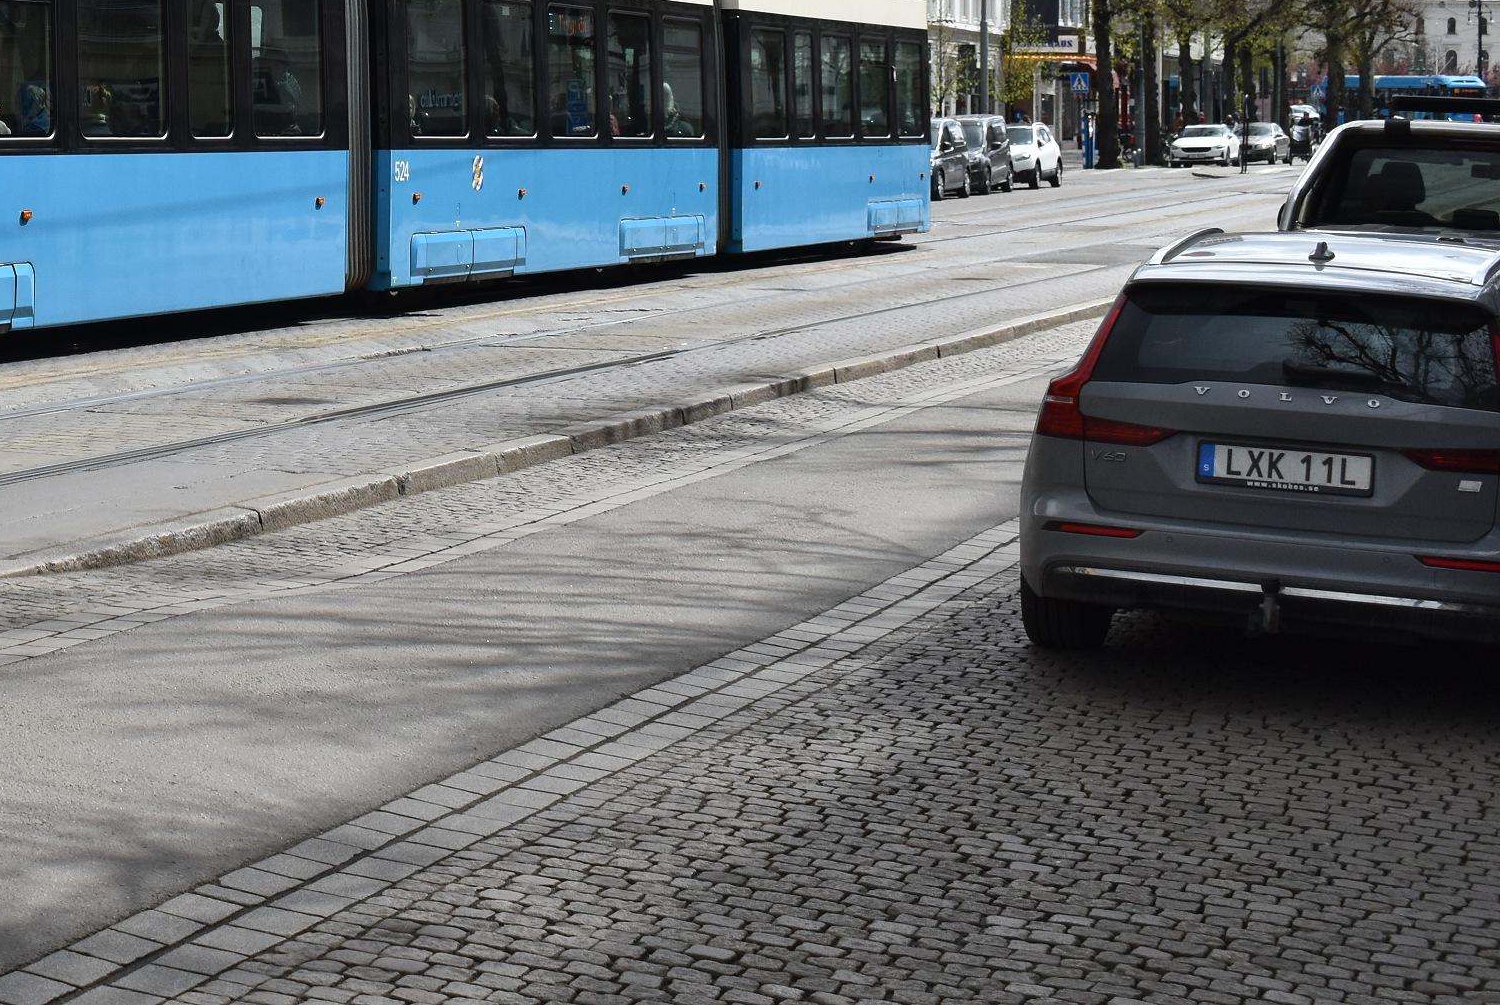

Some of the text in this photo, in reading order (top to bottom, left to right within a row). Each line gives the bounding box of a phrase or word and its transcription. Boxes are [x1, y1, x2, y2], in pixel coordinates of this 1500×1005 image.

[394, 161, 409, 181] 524
[1193, 386, 1381, 409] VOLVO
[1091, 449, 1126, 462] V60
[1203, 463, 1210, 472] S
[1226, 448, 1356, 486] LXK 11L
